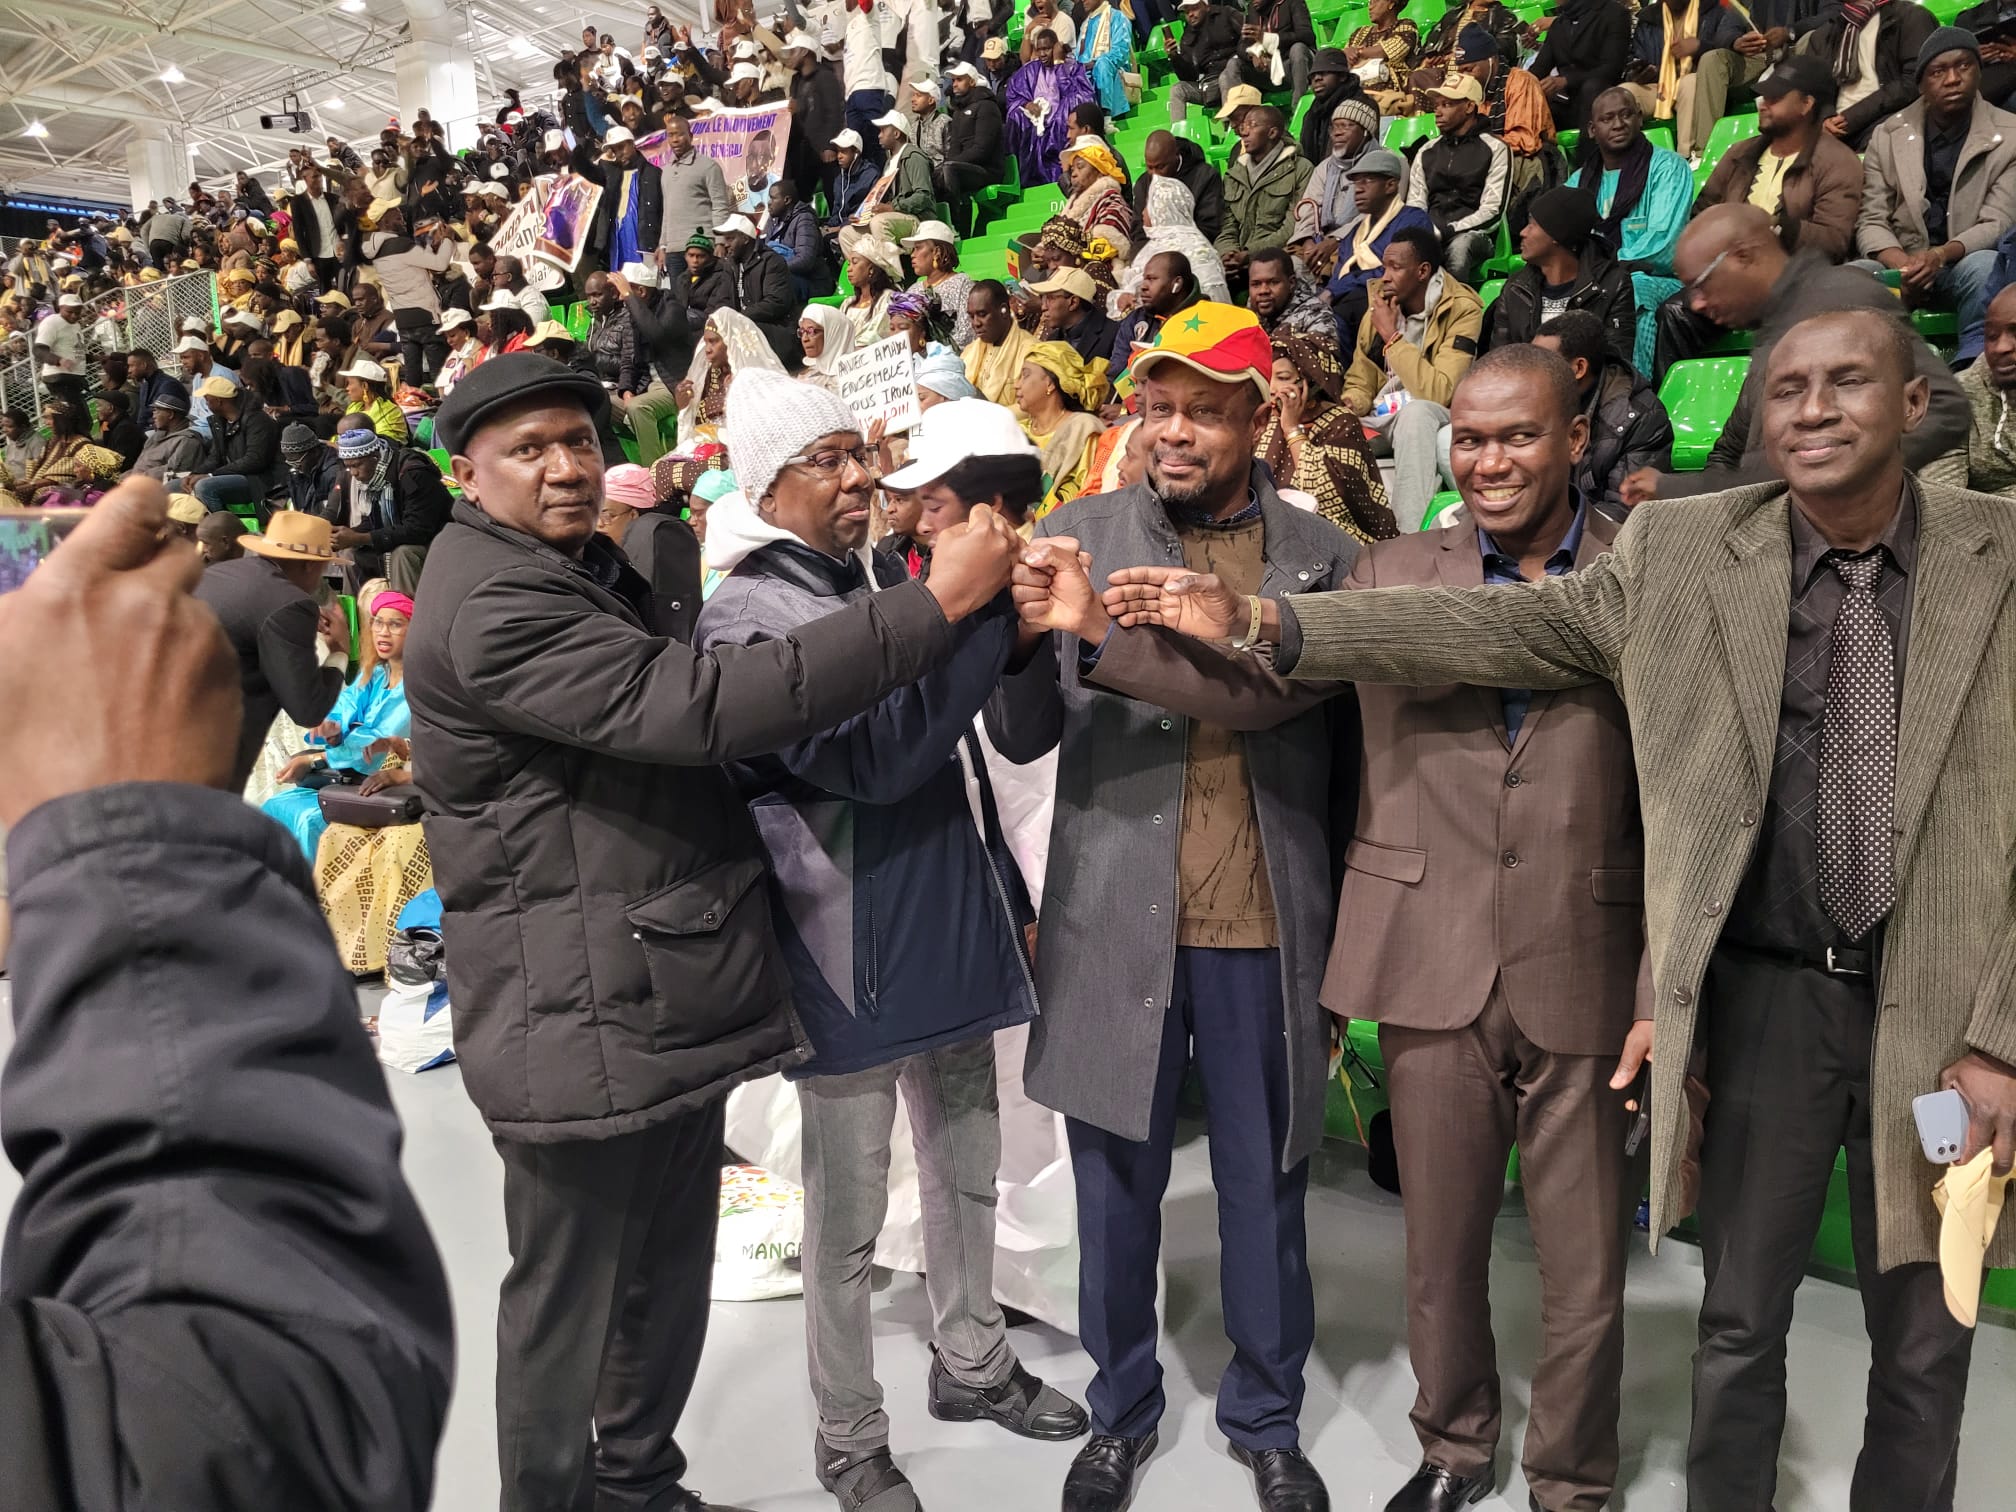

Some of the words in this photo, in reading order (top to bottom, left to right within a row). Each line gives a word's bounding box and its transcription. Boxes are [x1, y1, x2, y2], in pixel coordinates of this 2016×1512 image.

[838, 354, 869, 377] AVEC
[842, 360, 910, 399] ENSEMBLE,
[882, 383, 914, 405] IRONS
[884, 402, 909, 422] LOIN
